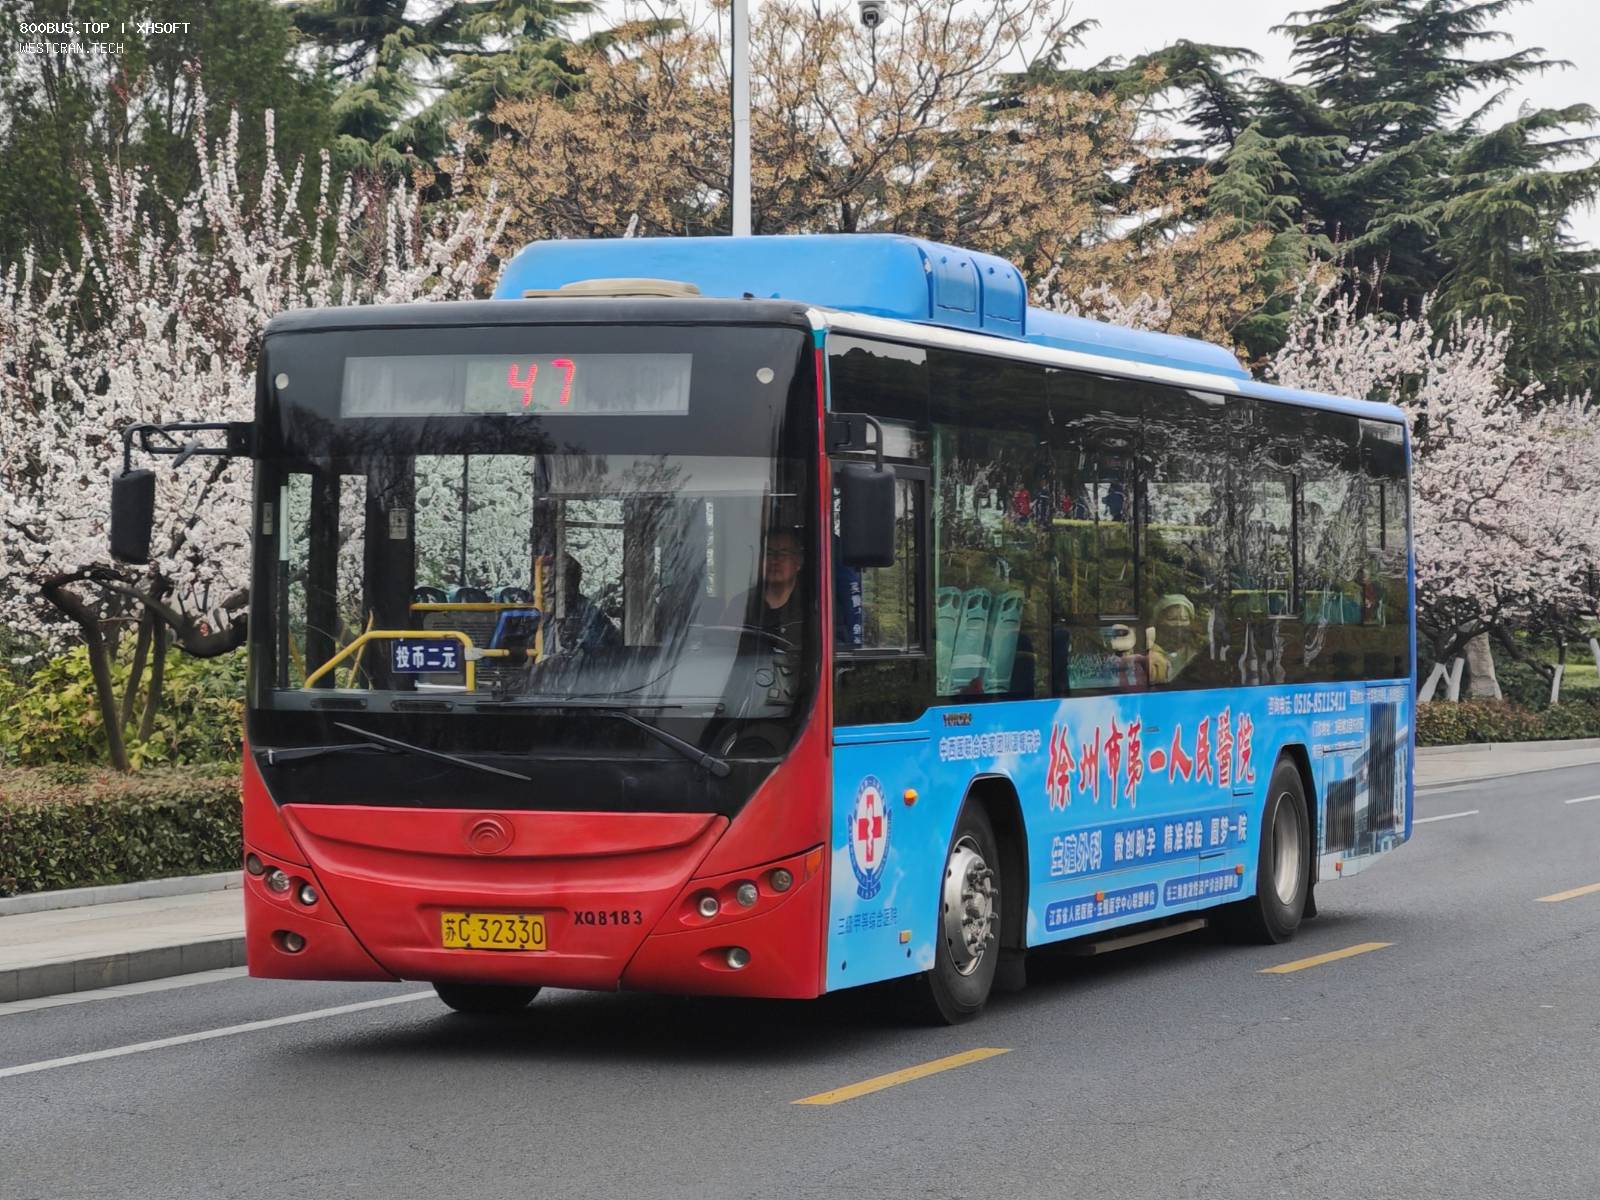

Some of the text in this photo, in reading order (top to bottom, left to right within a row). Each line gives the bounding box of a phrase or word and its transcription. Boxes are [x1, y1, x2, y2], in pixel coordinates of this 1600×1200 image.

[508, 358, 576, 406] 47
[396, 645, 456, 668] 投币二元
[1114, 827, 1156, 862] 微创助孕
[1164, 820, 1203, 854] 精准保胎
[574, 910, 643, 926] XQ8183
